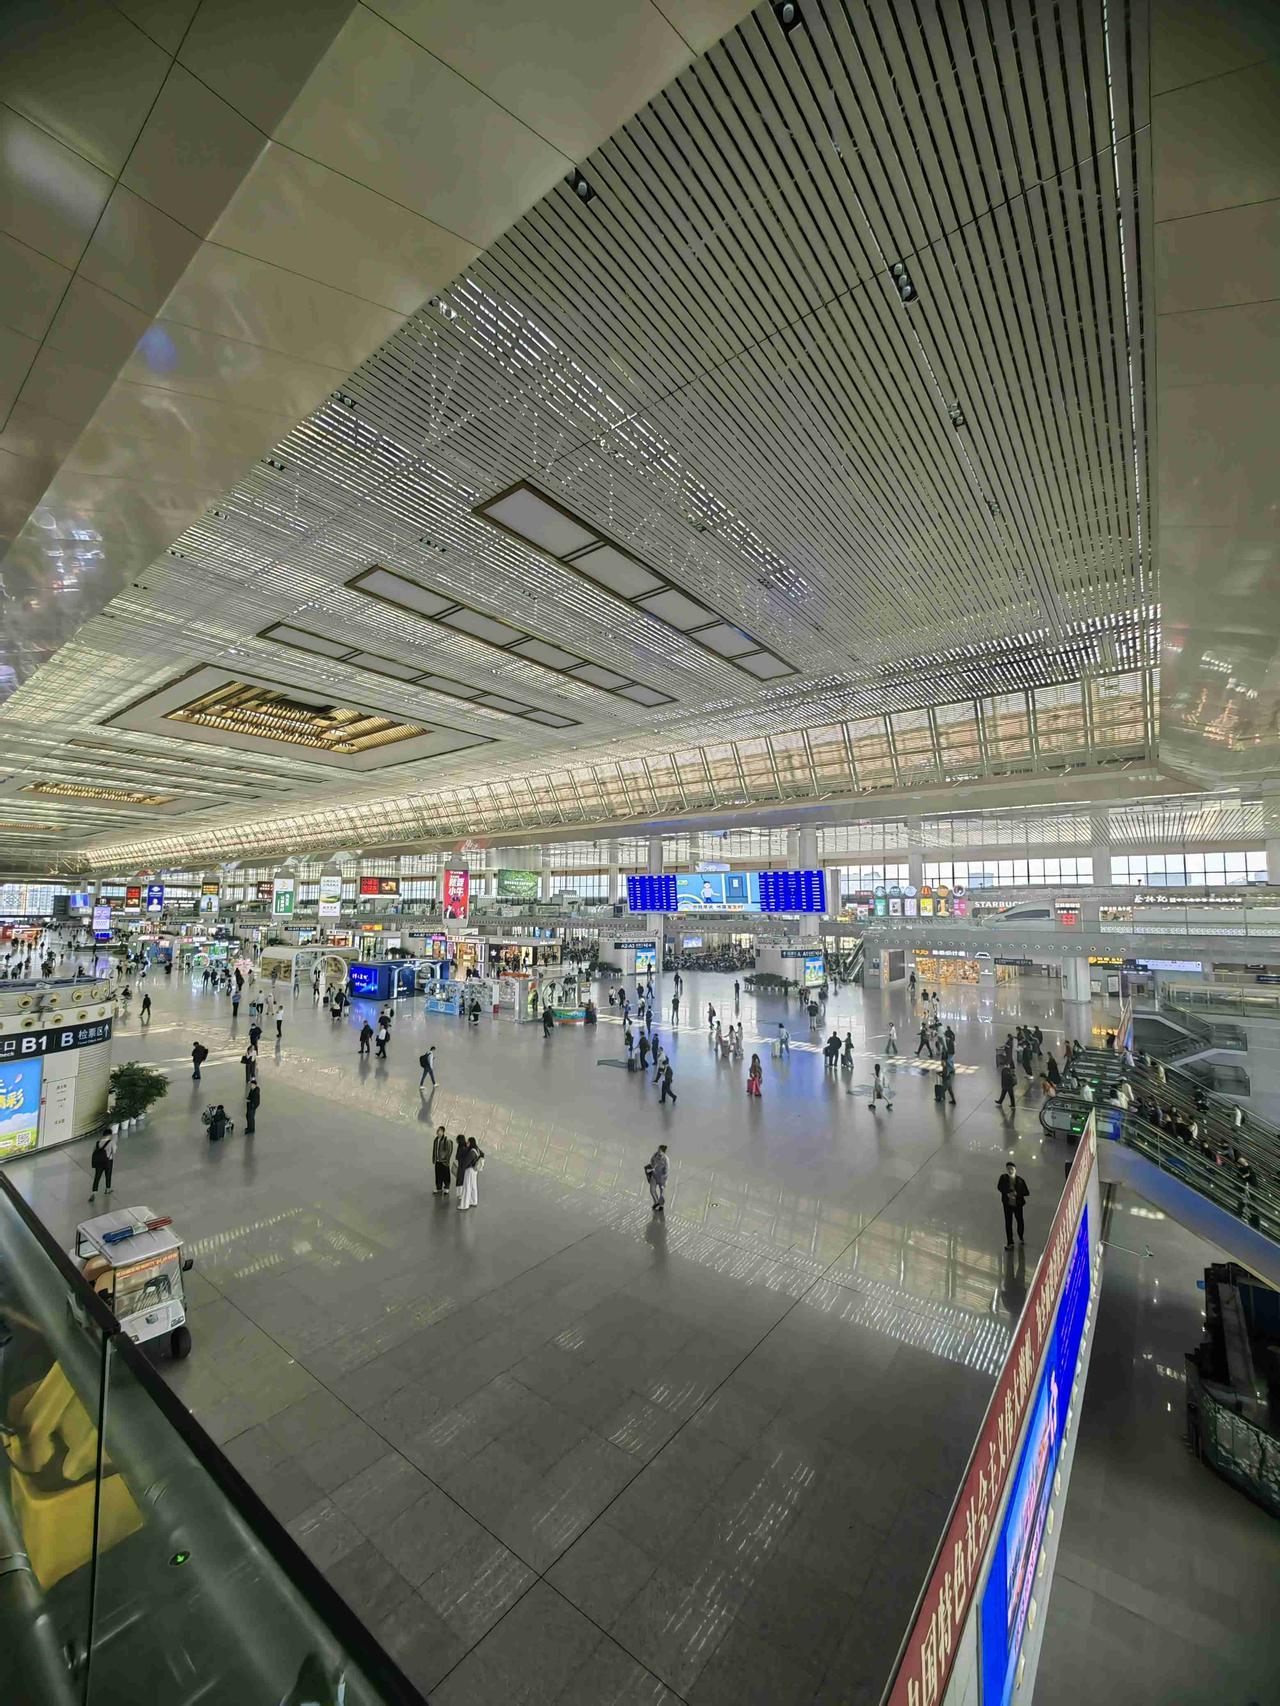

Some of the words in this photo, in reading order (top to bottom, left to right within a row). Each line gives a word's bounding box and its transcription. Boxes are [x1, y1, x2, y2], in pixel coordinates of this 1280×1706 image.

[974, 900, 1032, 909] STARBUC
[61, 1032, 74, 1047] B
[78, 1026, 104, 1040] 检票区
[21, 1035, 48, 1053] B1
